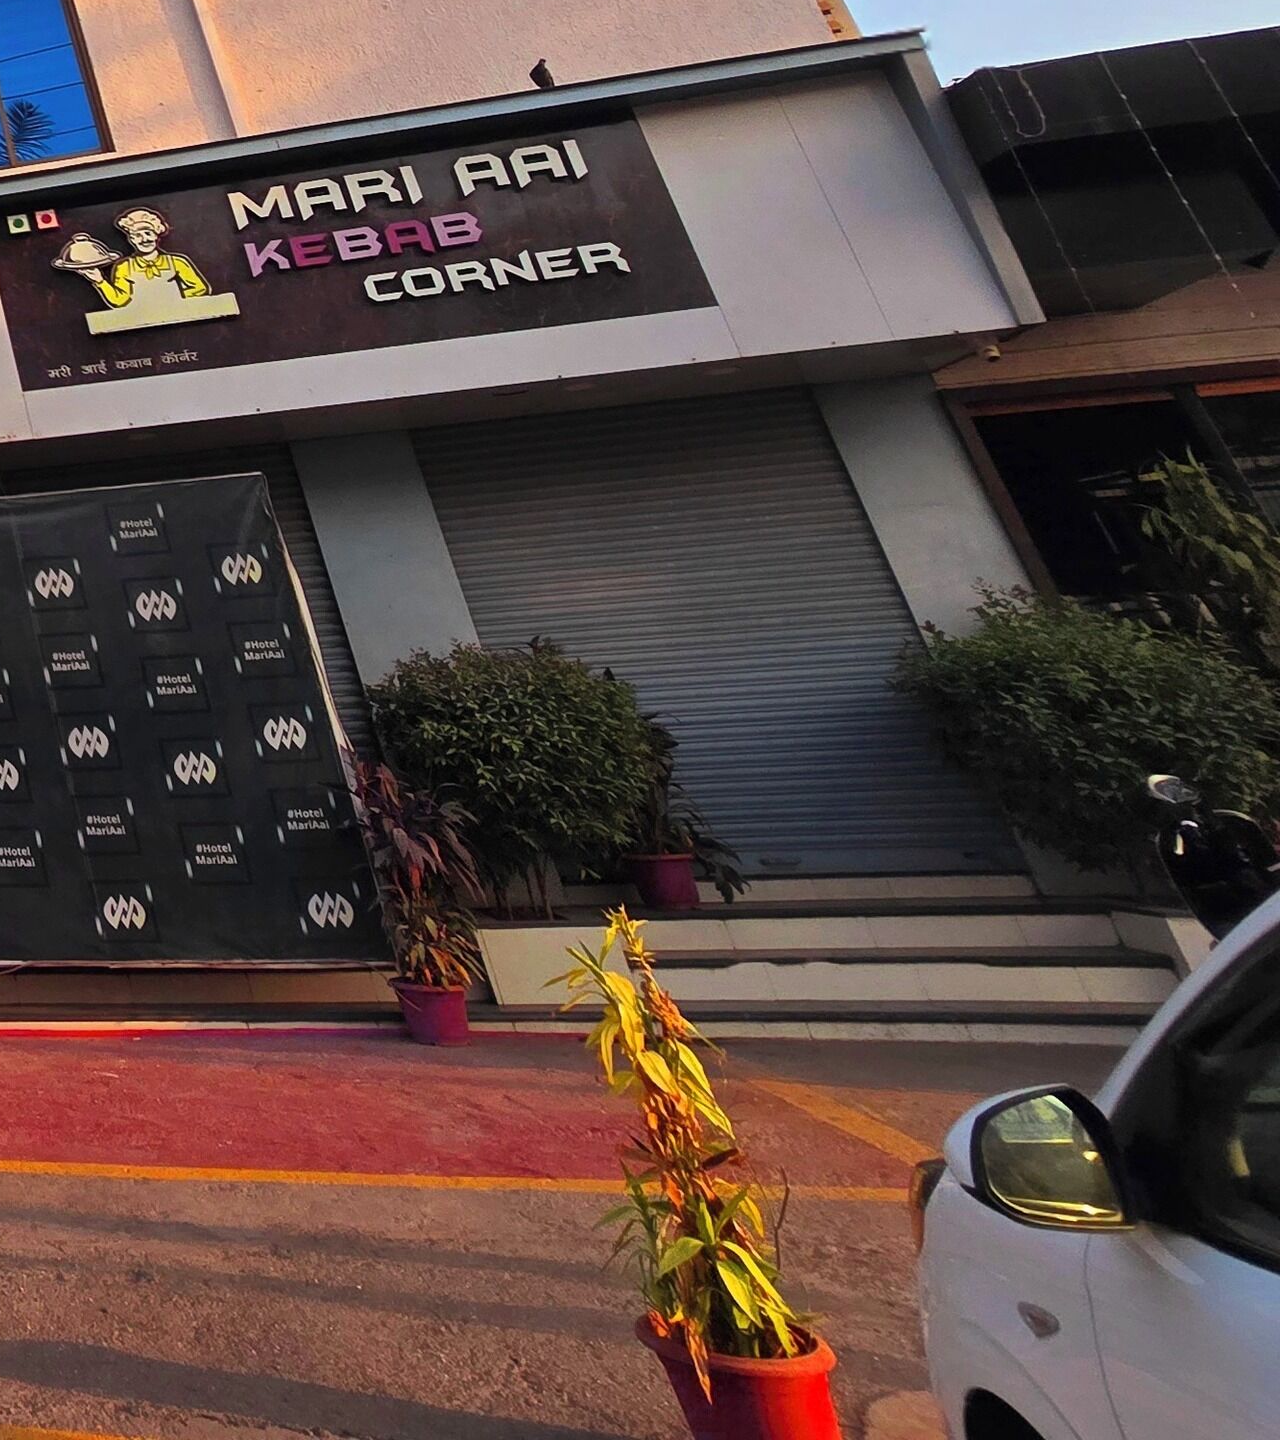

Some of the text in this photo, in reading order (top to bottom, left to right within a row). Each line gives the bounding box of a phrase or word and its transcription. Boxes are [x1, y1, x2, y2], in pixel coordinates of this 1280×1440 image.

[226, 139, 589, 231] MARI AAI
[244, 211, 484, 278] KEBAB
[363, 242, 631, 302] CORNER
[80, 359, 108, 375] आई
[120, 518, 153, 529] #Hotel
[244, 639, 279, 650] #Hotel
[52, 650, 85, 661] #Hotel
[156, 674, 192, 685] #Hotel
[287, 807, 324, 819] #Hotel
[86, 814, 121, 825] #Hotel
[196, 843, 232, 854] #Hotel
